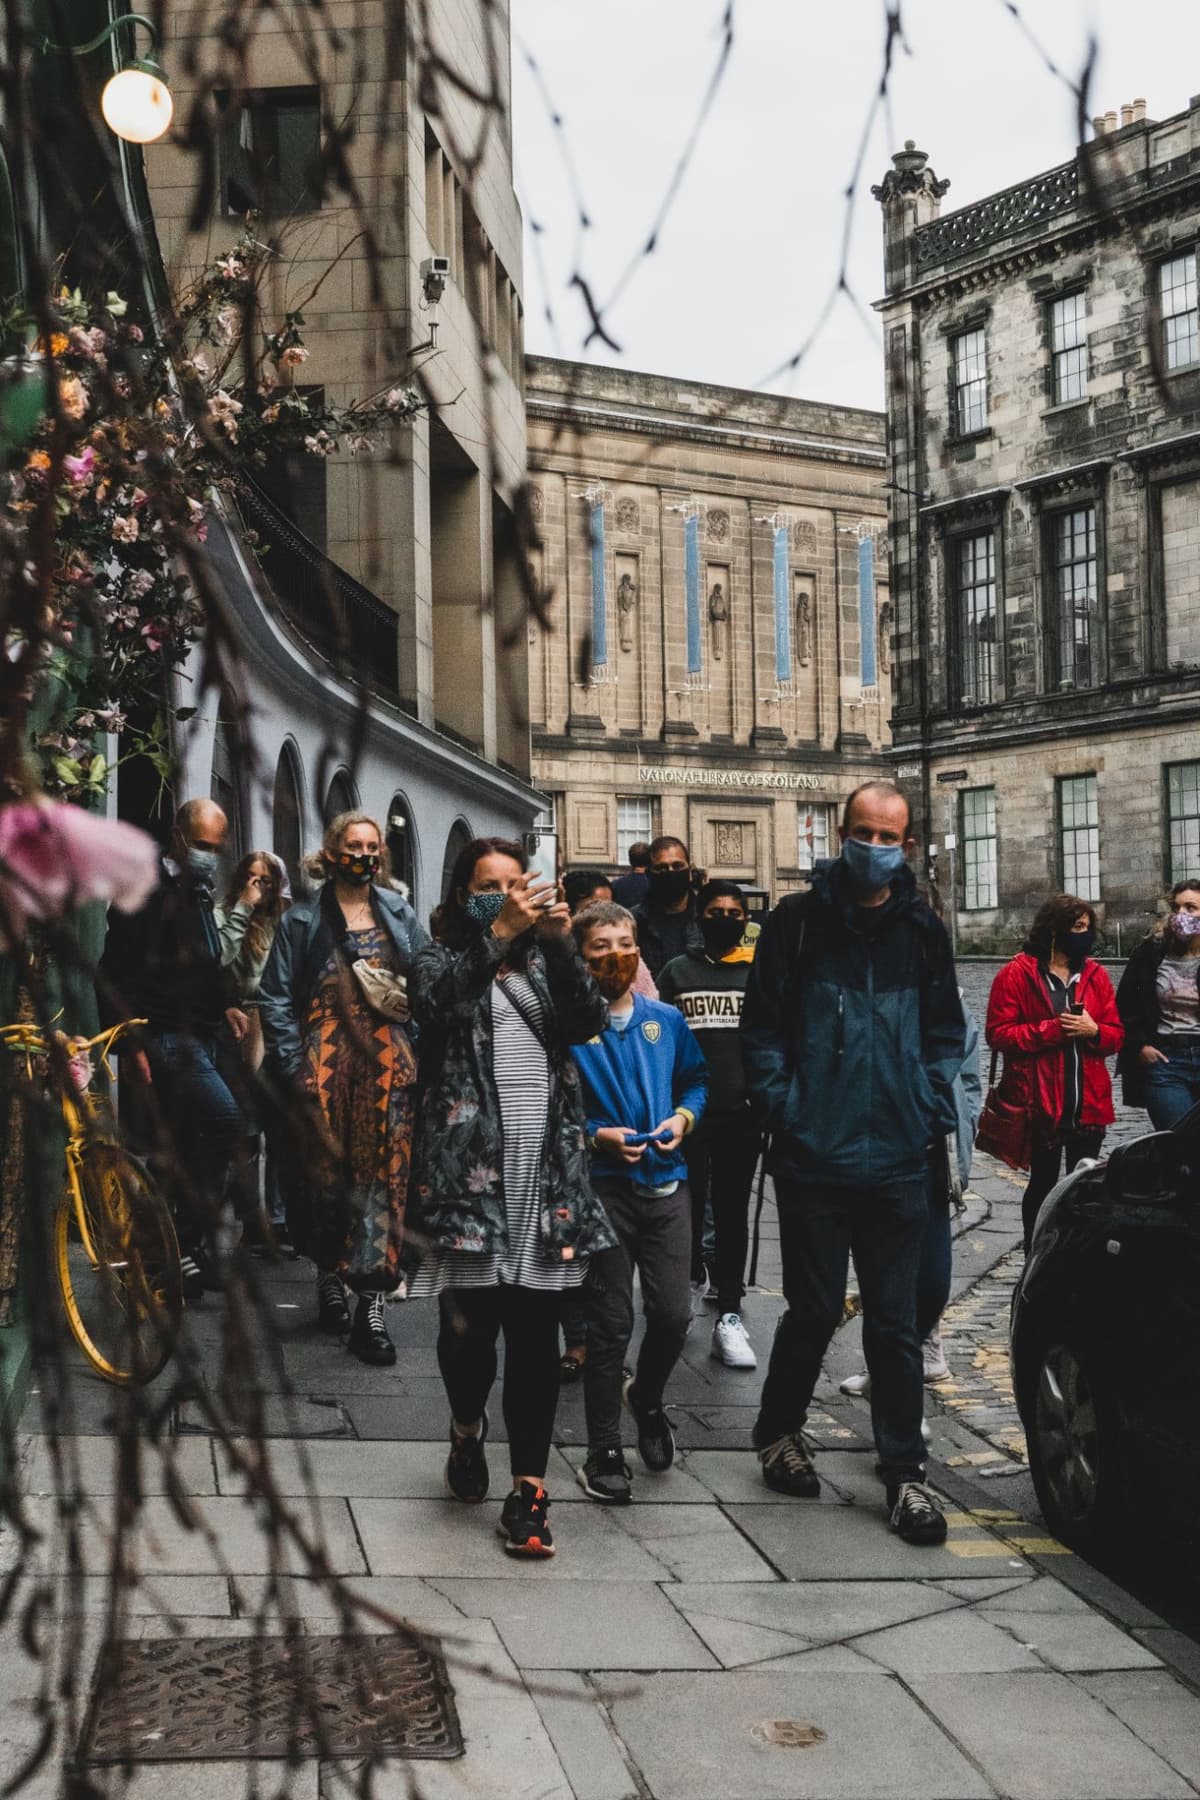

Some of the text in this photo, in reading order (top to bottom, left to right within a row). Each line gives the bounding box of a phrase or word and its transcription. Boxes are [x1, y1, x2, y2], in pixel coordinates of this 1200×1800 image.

[640, 768, 820, 789] NATIONAL LIBRARY OF SCOTLAND
